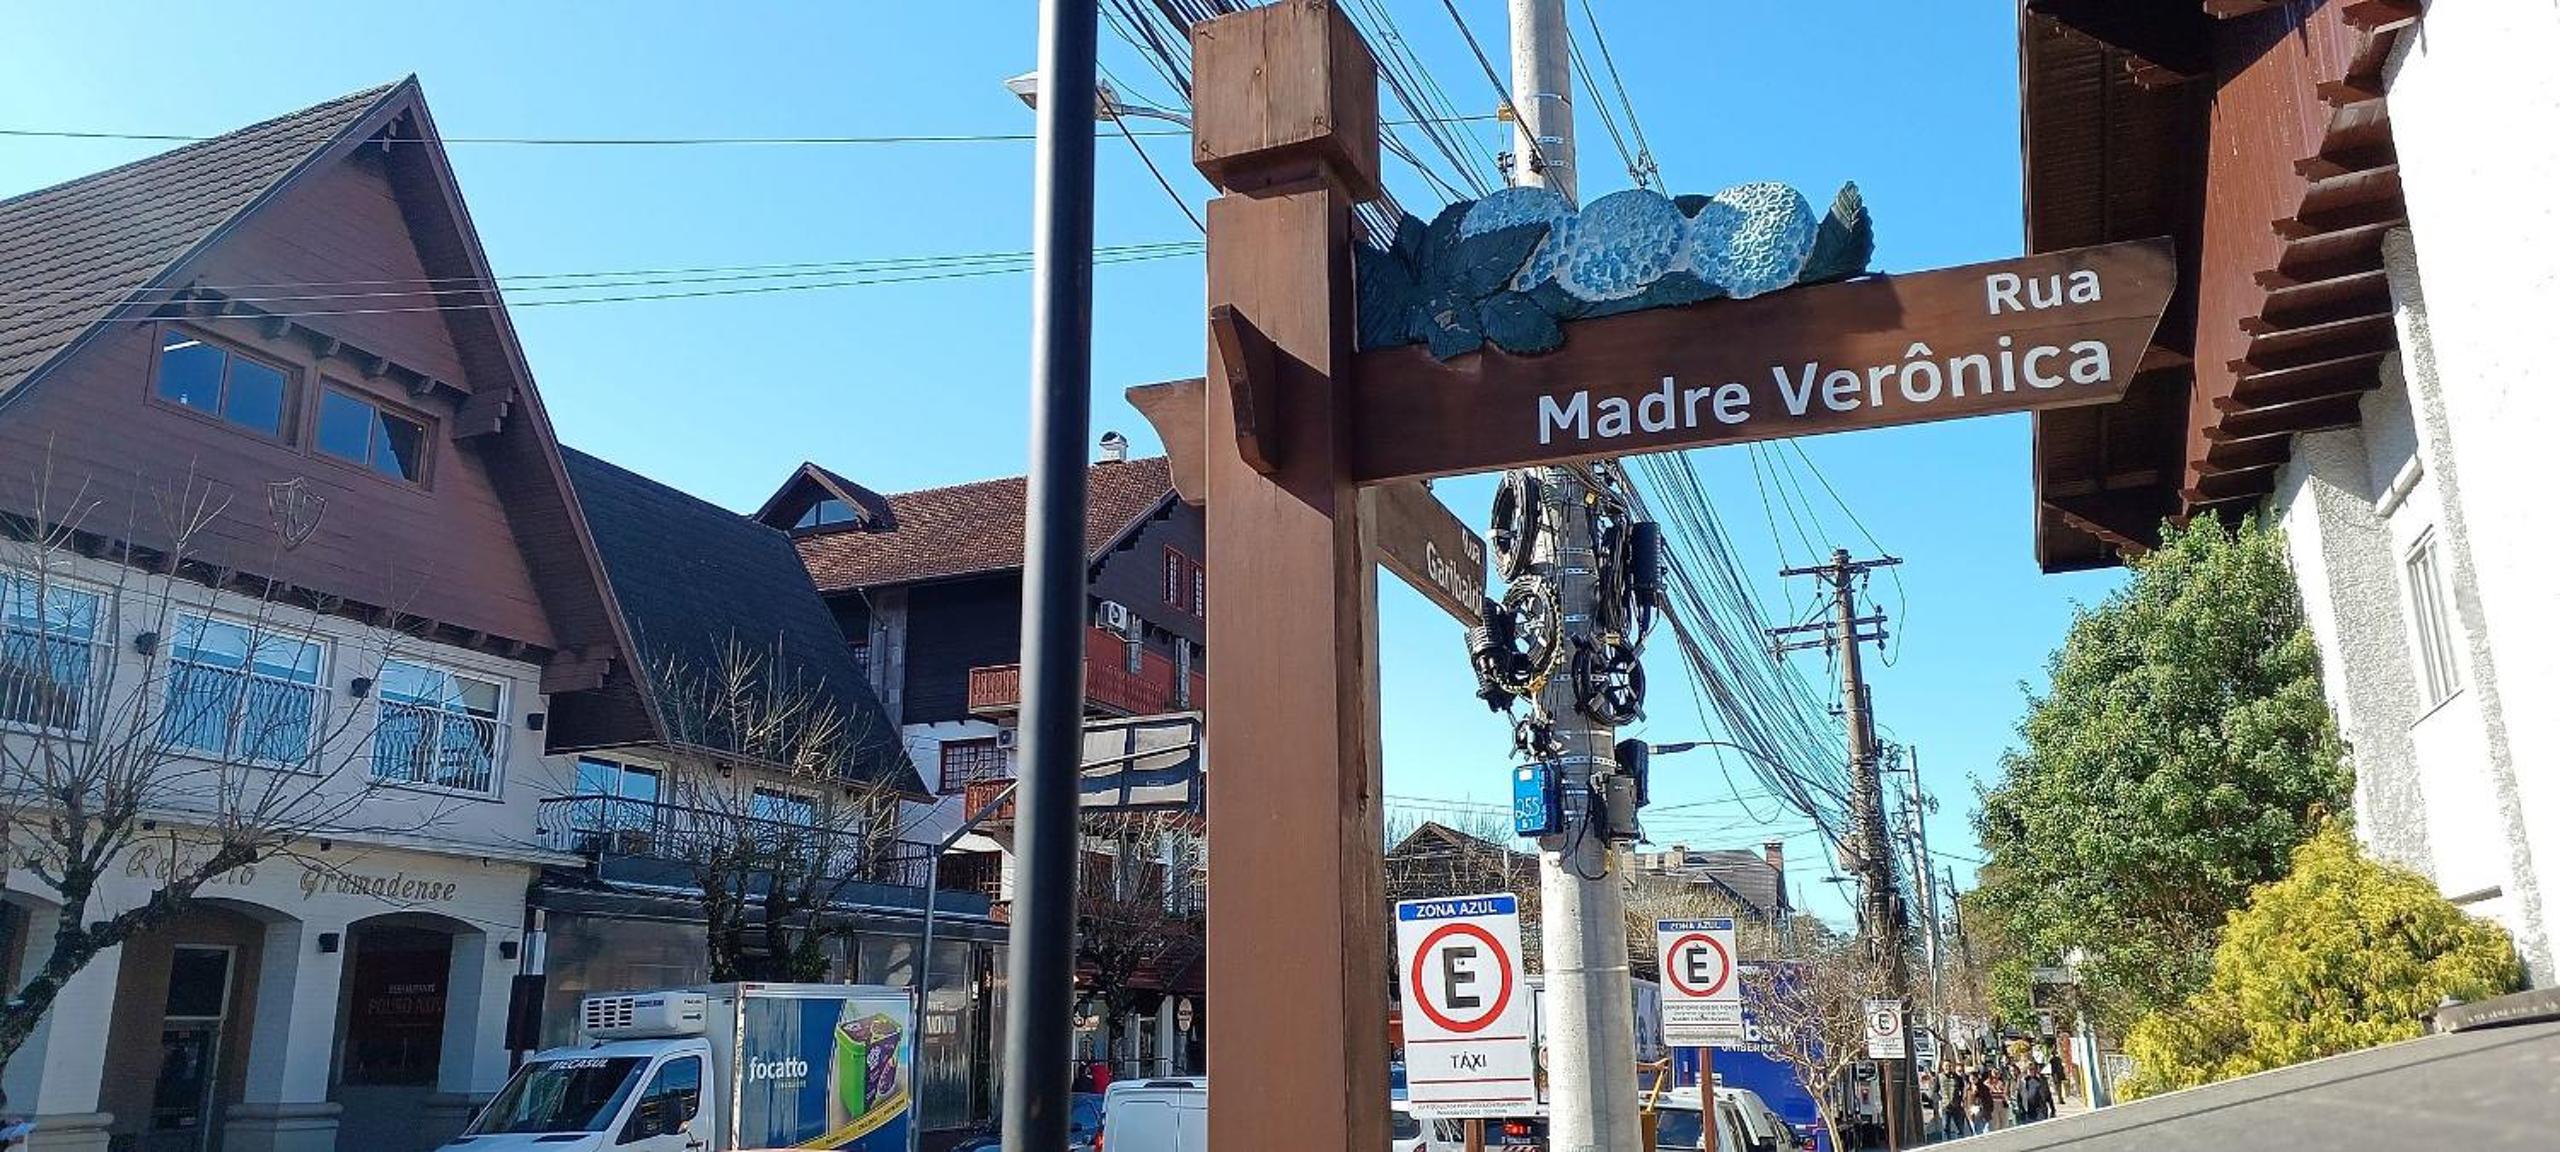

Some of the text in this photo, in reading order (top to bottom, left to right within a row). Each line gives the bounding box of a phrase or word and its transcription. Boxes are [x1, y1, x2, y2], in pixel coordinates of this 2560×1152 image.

[1985, 269, 2102, 315] Rua
[1538, 335, 2112, 446] Madre Verônica
[1426, 541, 1483, 616] Garibaldi
[299, 866, 458, 901] Gramadense
[1416, 900, 1498, 919] ZONA AZUL
[1696, 920, 1722, 930] AZUL
[1442, 946, 1481, 1010] E
[1686, 947, 1710, 984] E
[748, 1056, 808, 1084] focatto
[1450, 1051, 1487, 1069] TÁXI
